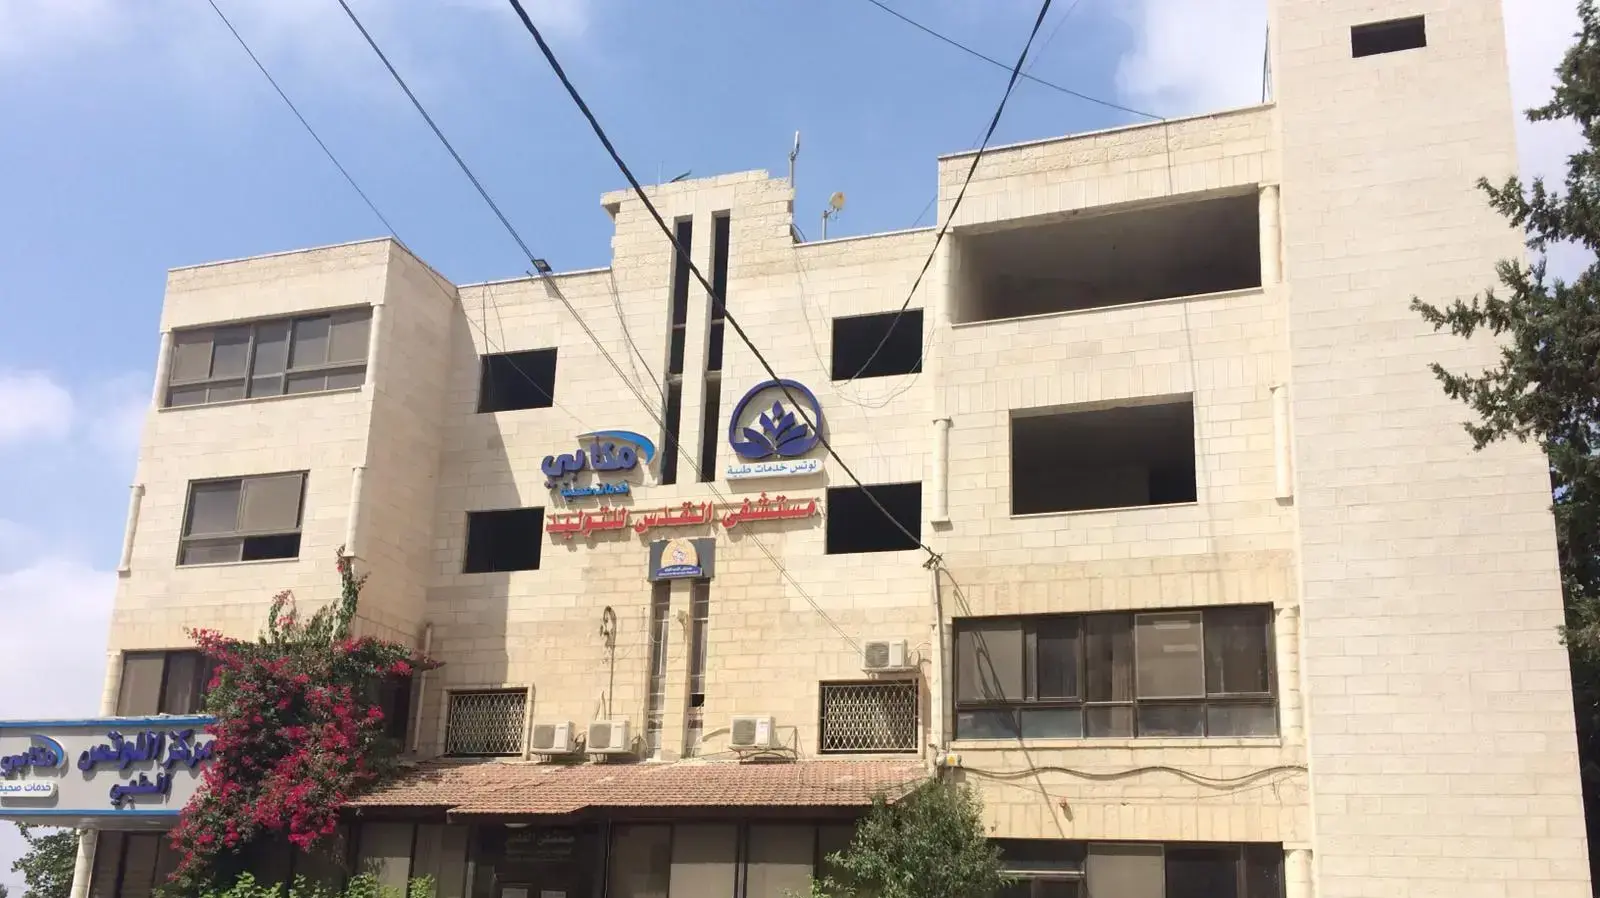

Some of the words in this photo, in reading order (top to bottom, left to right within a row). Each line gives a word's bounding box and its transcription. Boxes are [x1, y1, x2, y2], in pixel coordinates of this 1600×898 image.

[727, 465, 752, 477] طبية
[755, 463, 787, 473] خدمات
[790, 460, 817, 473] لوتس
[546, 506, 630, 539] للتوليد
[634, 501, 713, 534] القدس
[722, 489, 817, 528] مستشفى
[77, 728, 166, 771] اللوتس
[160, 729, 216, 769] مركز
[25, 781, 51, 792] خدمات
